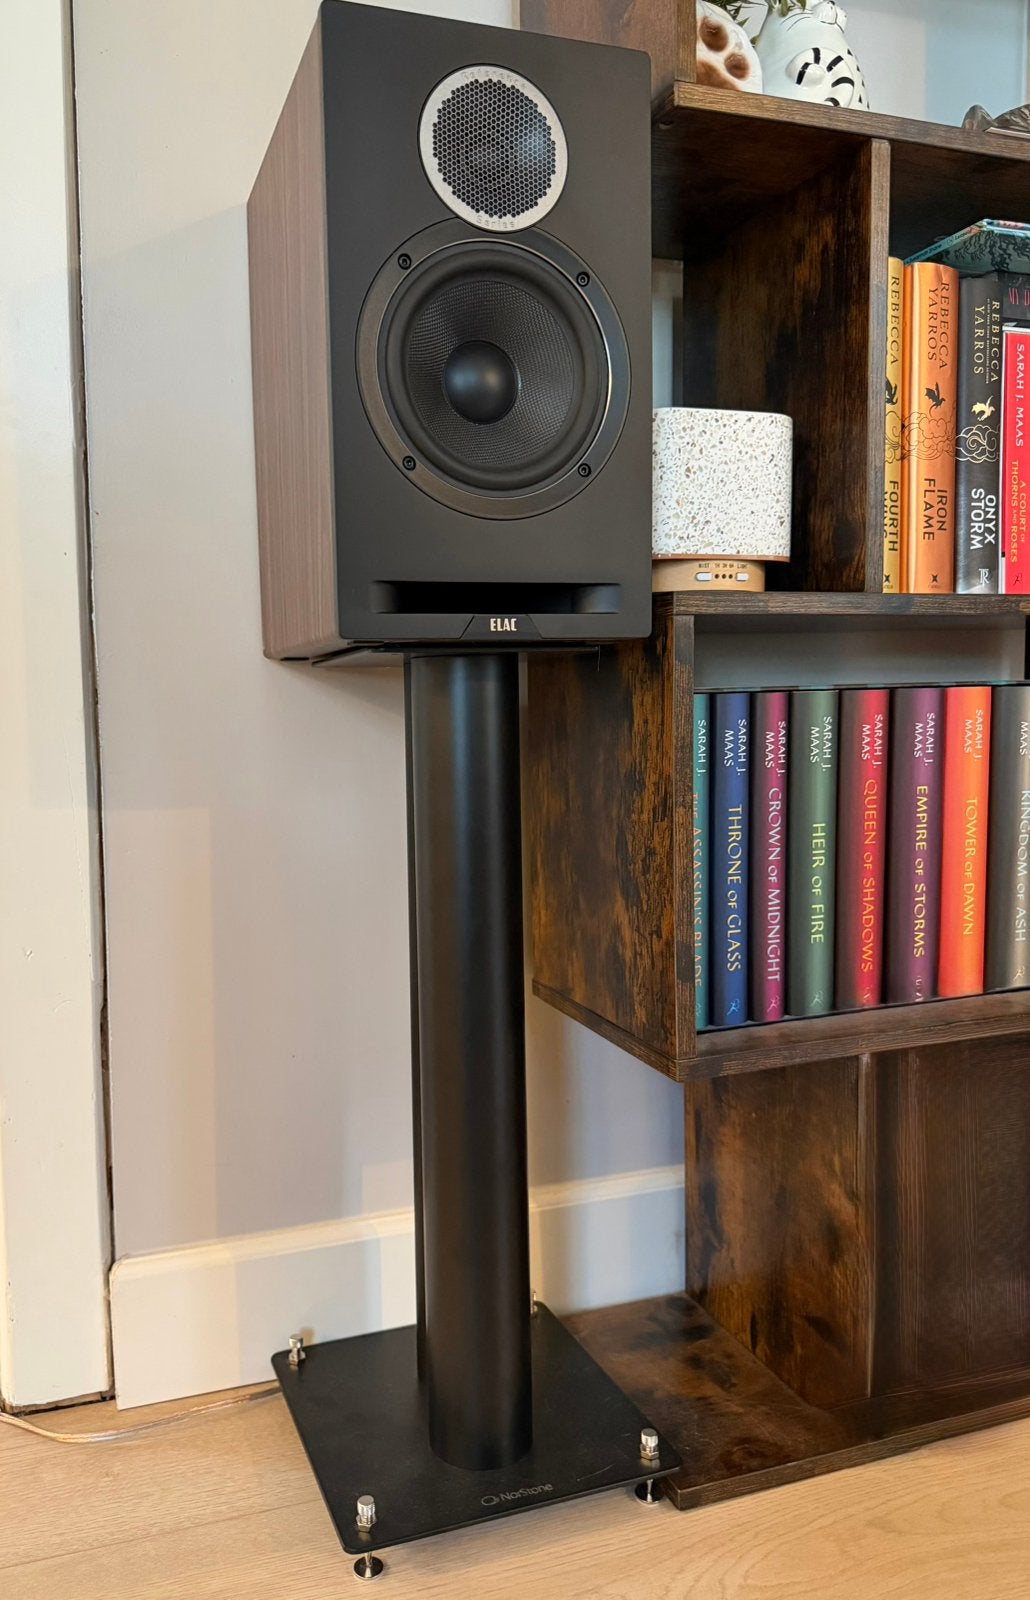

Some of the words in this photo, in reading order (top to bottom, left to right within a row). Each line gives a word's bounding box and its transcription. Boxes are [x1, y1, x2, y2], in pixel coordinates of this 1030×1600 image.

[891, 276, 900, 365] REBECCA
[928, 287, 938, 361] YARROS
[939, 282, 950, 368] REBECCA
[974, 306, 985, 374] YARROS
[991, 301, 1000, 382] REBECCA
[1016, 344, 1024, 389] SARAH
[1016, 407, 1024, 447] MAAS
[888, 480, 899, 552] FOURTH
[923, 478, 935, 541] FLAME
[937, 489, 947, 531] IRON
[970, 488, 984, 550] STORM
[984, 495, 996, 544] ONYX
[490, 618, 517, 631] ELAC
[698, 720, 706, 762] SARAH
[724, 730, 734, 767] MAAS
[738, 719, 746, 762] SARAH
[765, 731, 775, 768] MAAS
[778, 721, 786, 763] SARAH
[810, 726, 820, 763] MAAS
[823, 716, 832, 758] SARAH
[862, 724, 871, 760] MAAS
[873, 714, 883, 756] SARAH
[914, 722, 924, 758] MAAS
[925, 712, 935, 753] SARAH
[963, 719, 973, 753] MAAS
[975, 709, 983, 749] SARAH
[1019, 721, 1029, 756] MAAS
[696, 768, 706, 776] J.
[736, 766, 746, 776] J.
[776, 768, 786, 777] J.
[821, 762, 831, 772] J.
[872, 760, 882, 768] J.
[924, 758, 934, 766] J.
[973, 753, 982, 761] J.
[768, 787, 782, 860] CROWN
[864, 780, 878, 844] QUEEN
[916, 785, 928, 851] EMPIRE
[964, 797, 977, 858] TOWER
[727, 804, 742, 885] THRONE
[812, 823, 826, 868] HEIR
[1017, 790, 1030, 876] KINGDOM
[768, 865, 778, 883] OF
[864, 852, 873, 869] OF
[915, 858, 924, 876] OF
[964, 862, 973, 879] OF
[727, 890, 738, 909] OF
[811, 875, 822, 896] OF
[1017, 883, 1025, 900] OF
[811, 904, 825, 944] FIRE
[861, 877, 876, 972] SHADOWS
[914, 883, 926, 958] STORMS
[963, 882, 975, 936] DAWN
[1015, 906, 1027, 942] ASH
[727, 914, 742, 972] GLASS
[767, 888, 781, 981] MIDNIGHT
[500, 1484, 554, 1500] NorStone
